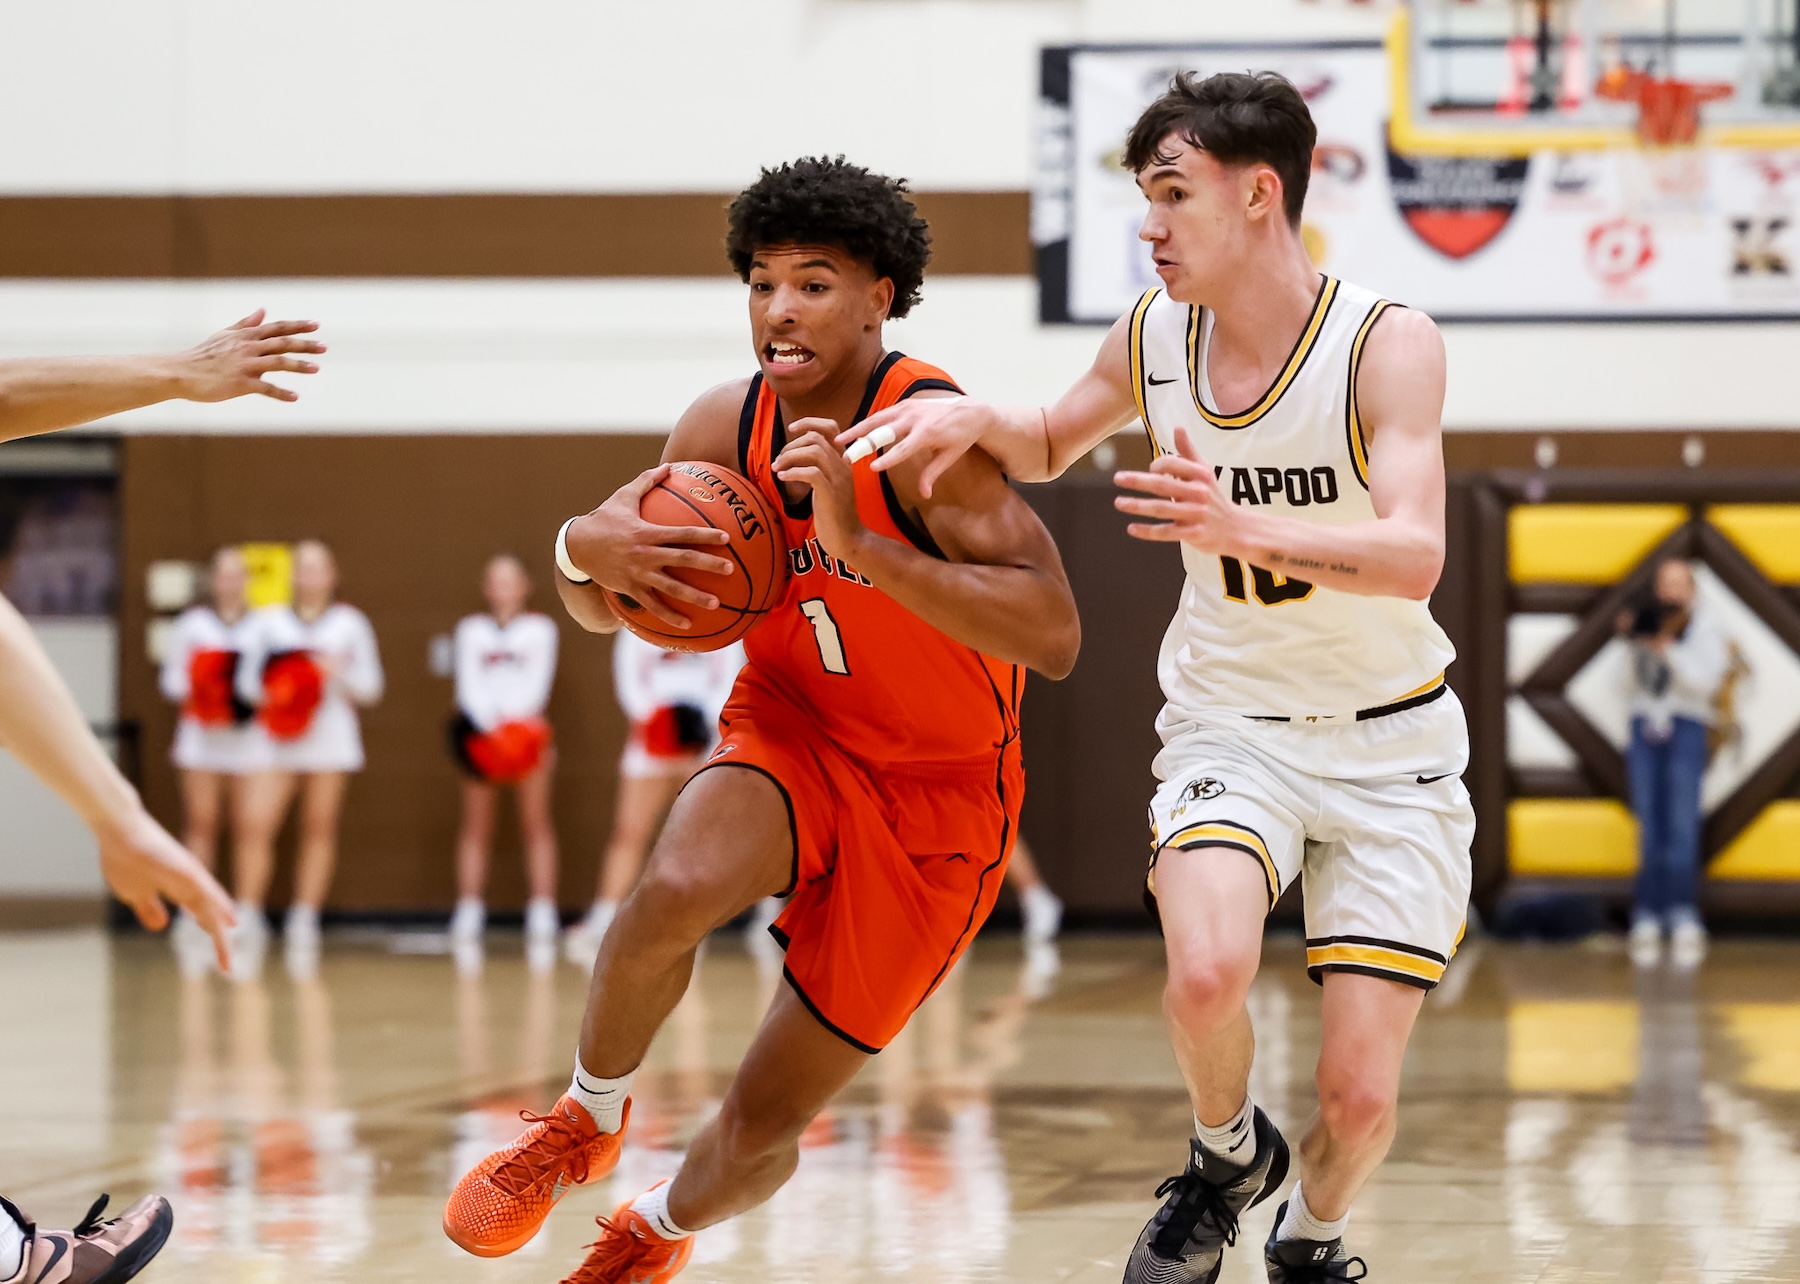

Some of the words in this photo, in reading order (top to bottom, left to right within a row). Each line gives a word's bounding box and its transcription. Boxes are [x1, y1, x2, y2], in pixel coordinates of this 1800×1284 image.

[1288, 557, 1325, 569] matter
[1330, 561, 1358, 575] when
[798, 597, 852, 676] 1
